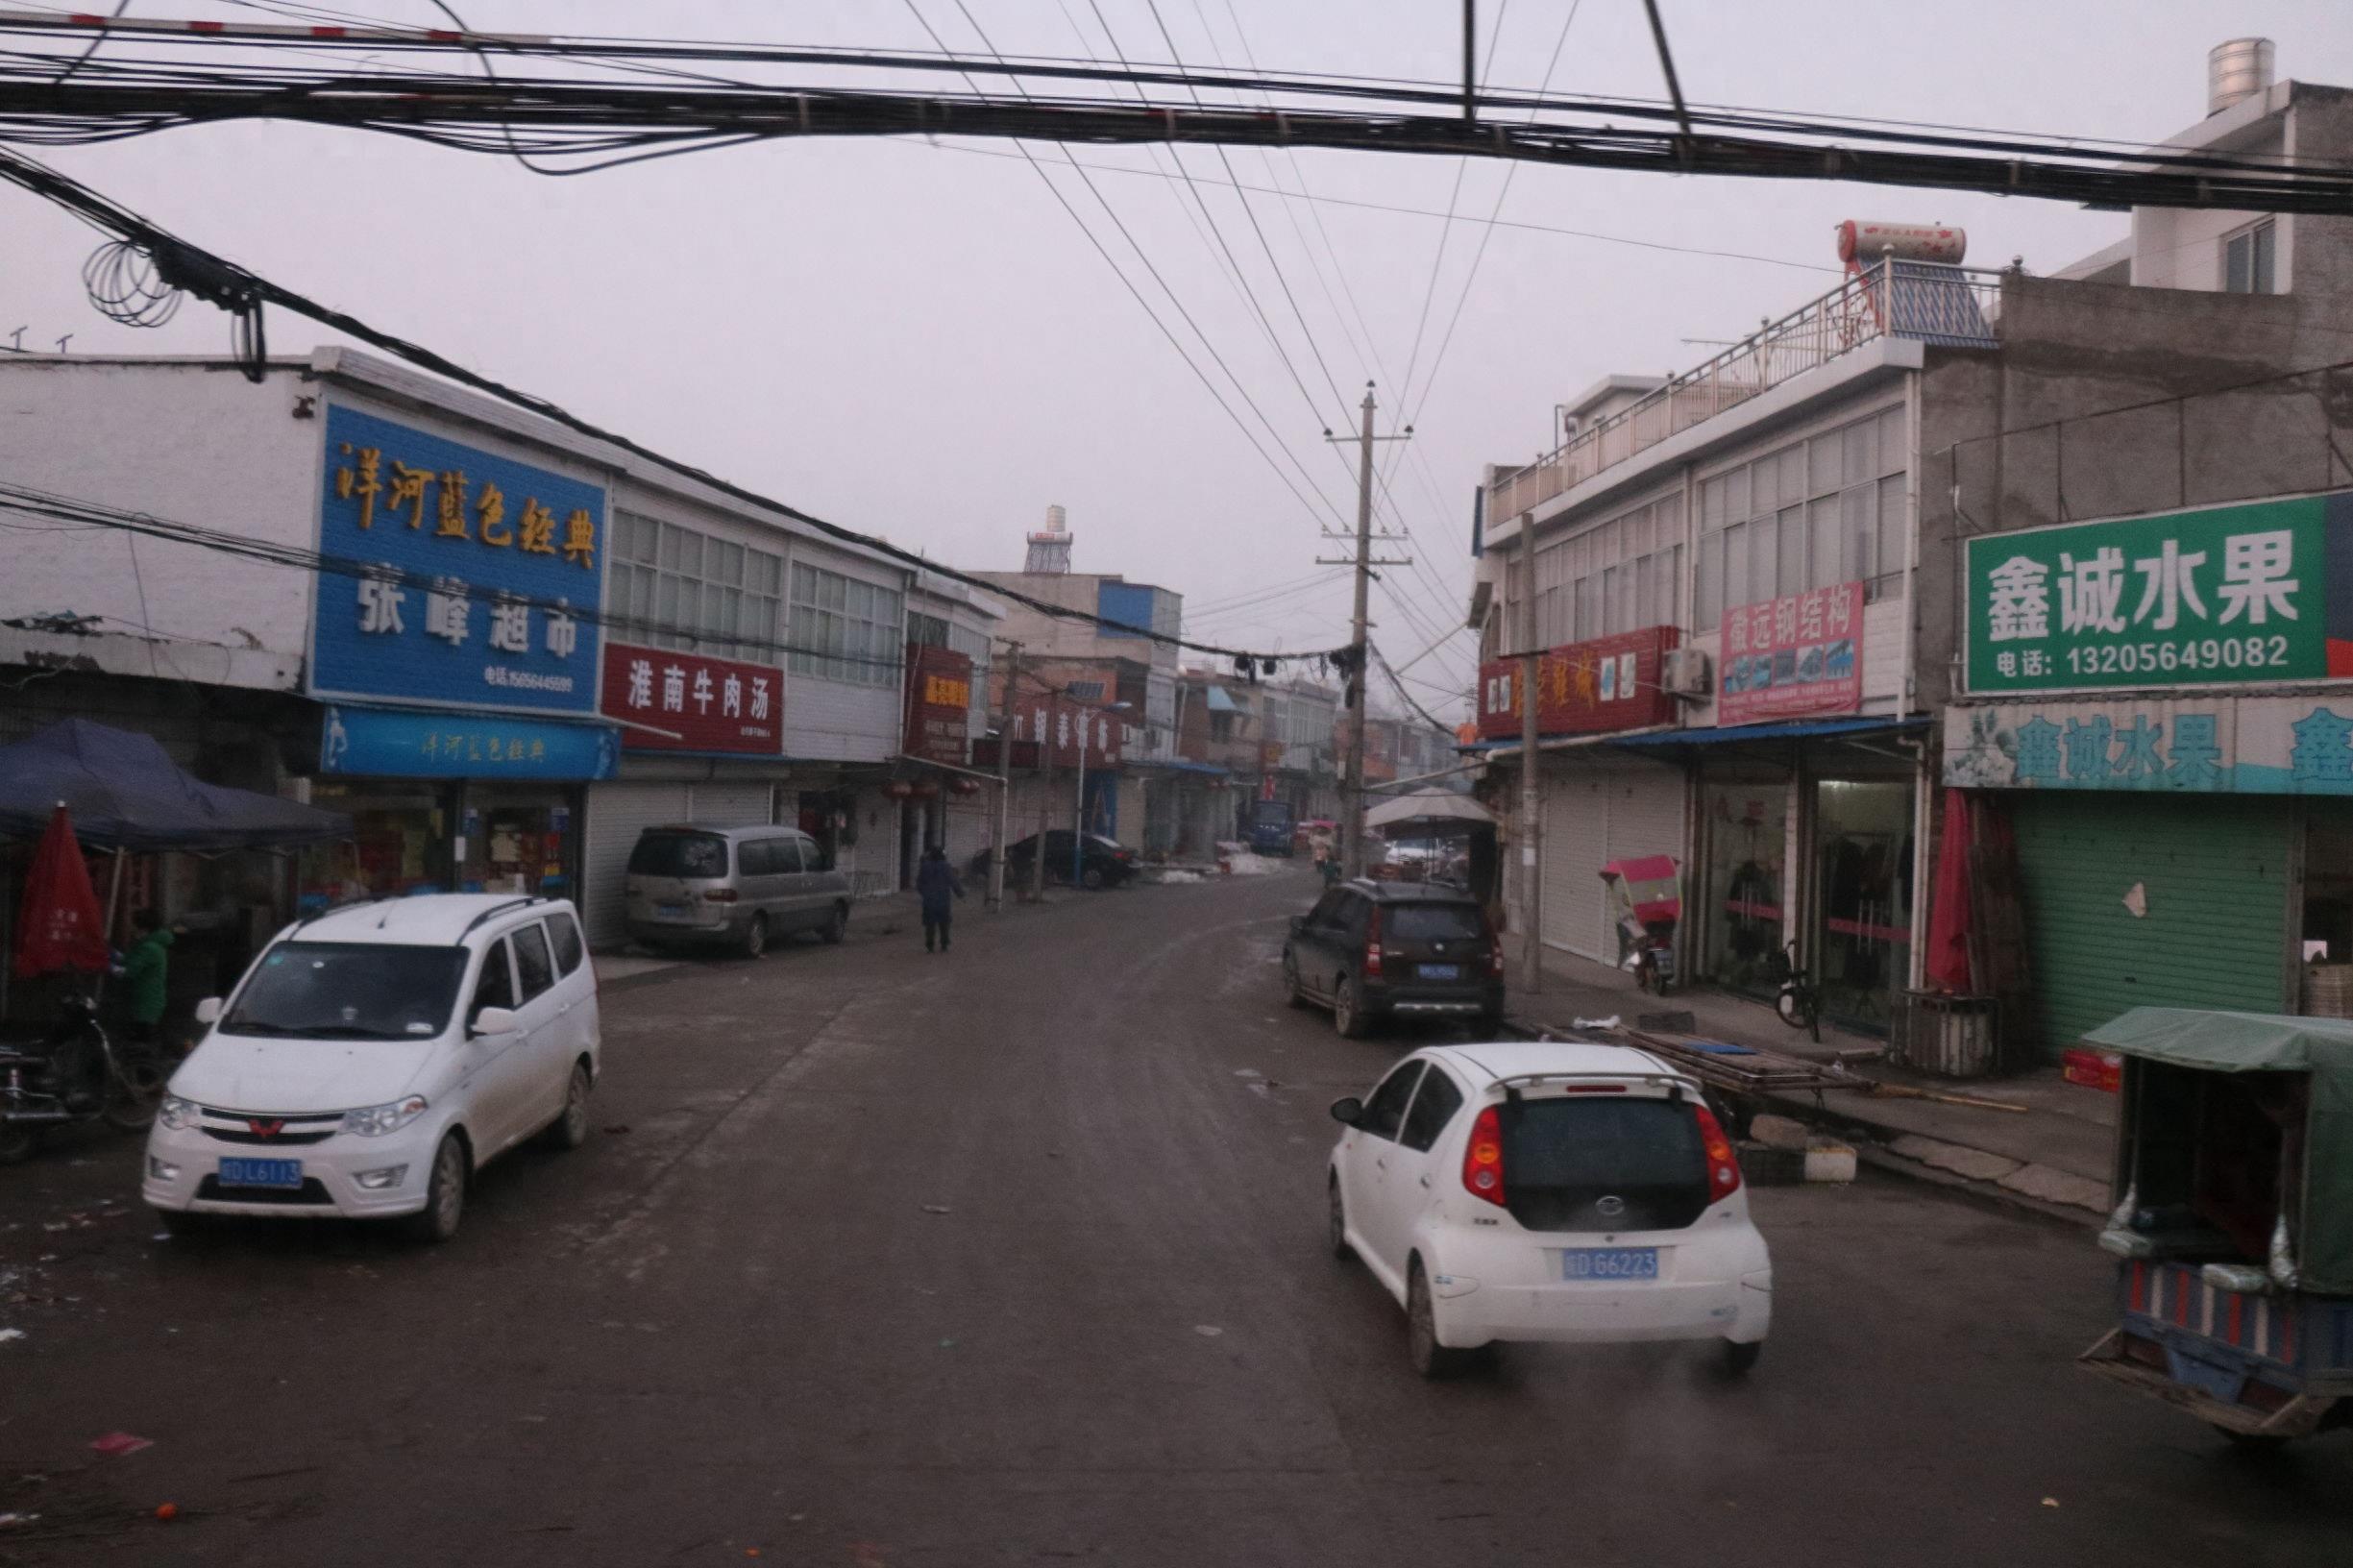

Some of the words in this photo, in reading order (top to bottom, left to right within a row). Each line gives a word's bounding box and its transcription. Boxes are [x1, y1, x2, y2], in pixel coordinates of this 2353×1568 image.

[1988, 528, 2300, 643] 鑫诚水果
[627, 658, 770, 721] 淮南牛肉汤
[2016, 714, 2221, 782] 鑫诚水果
